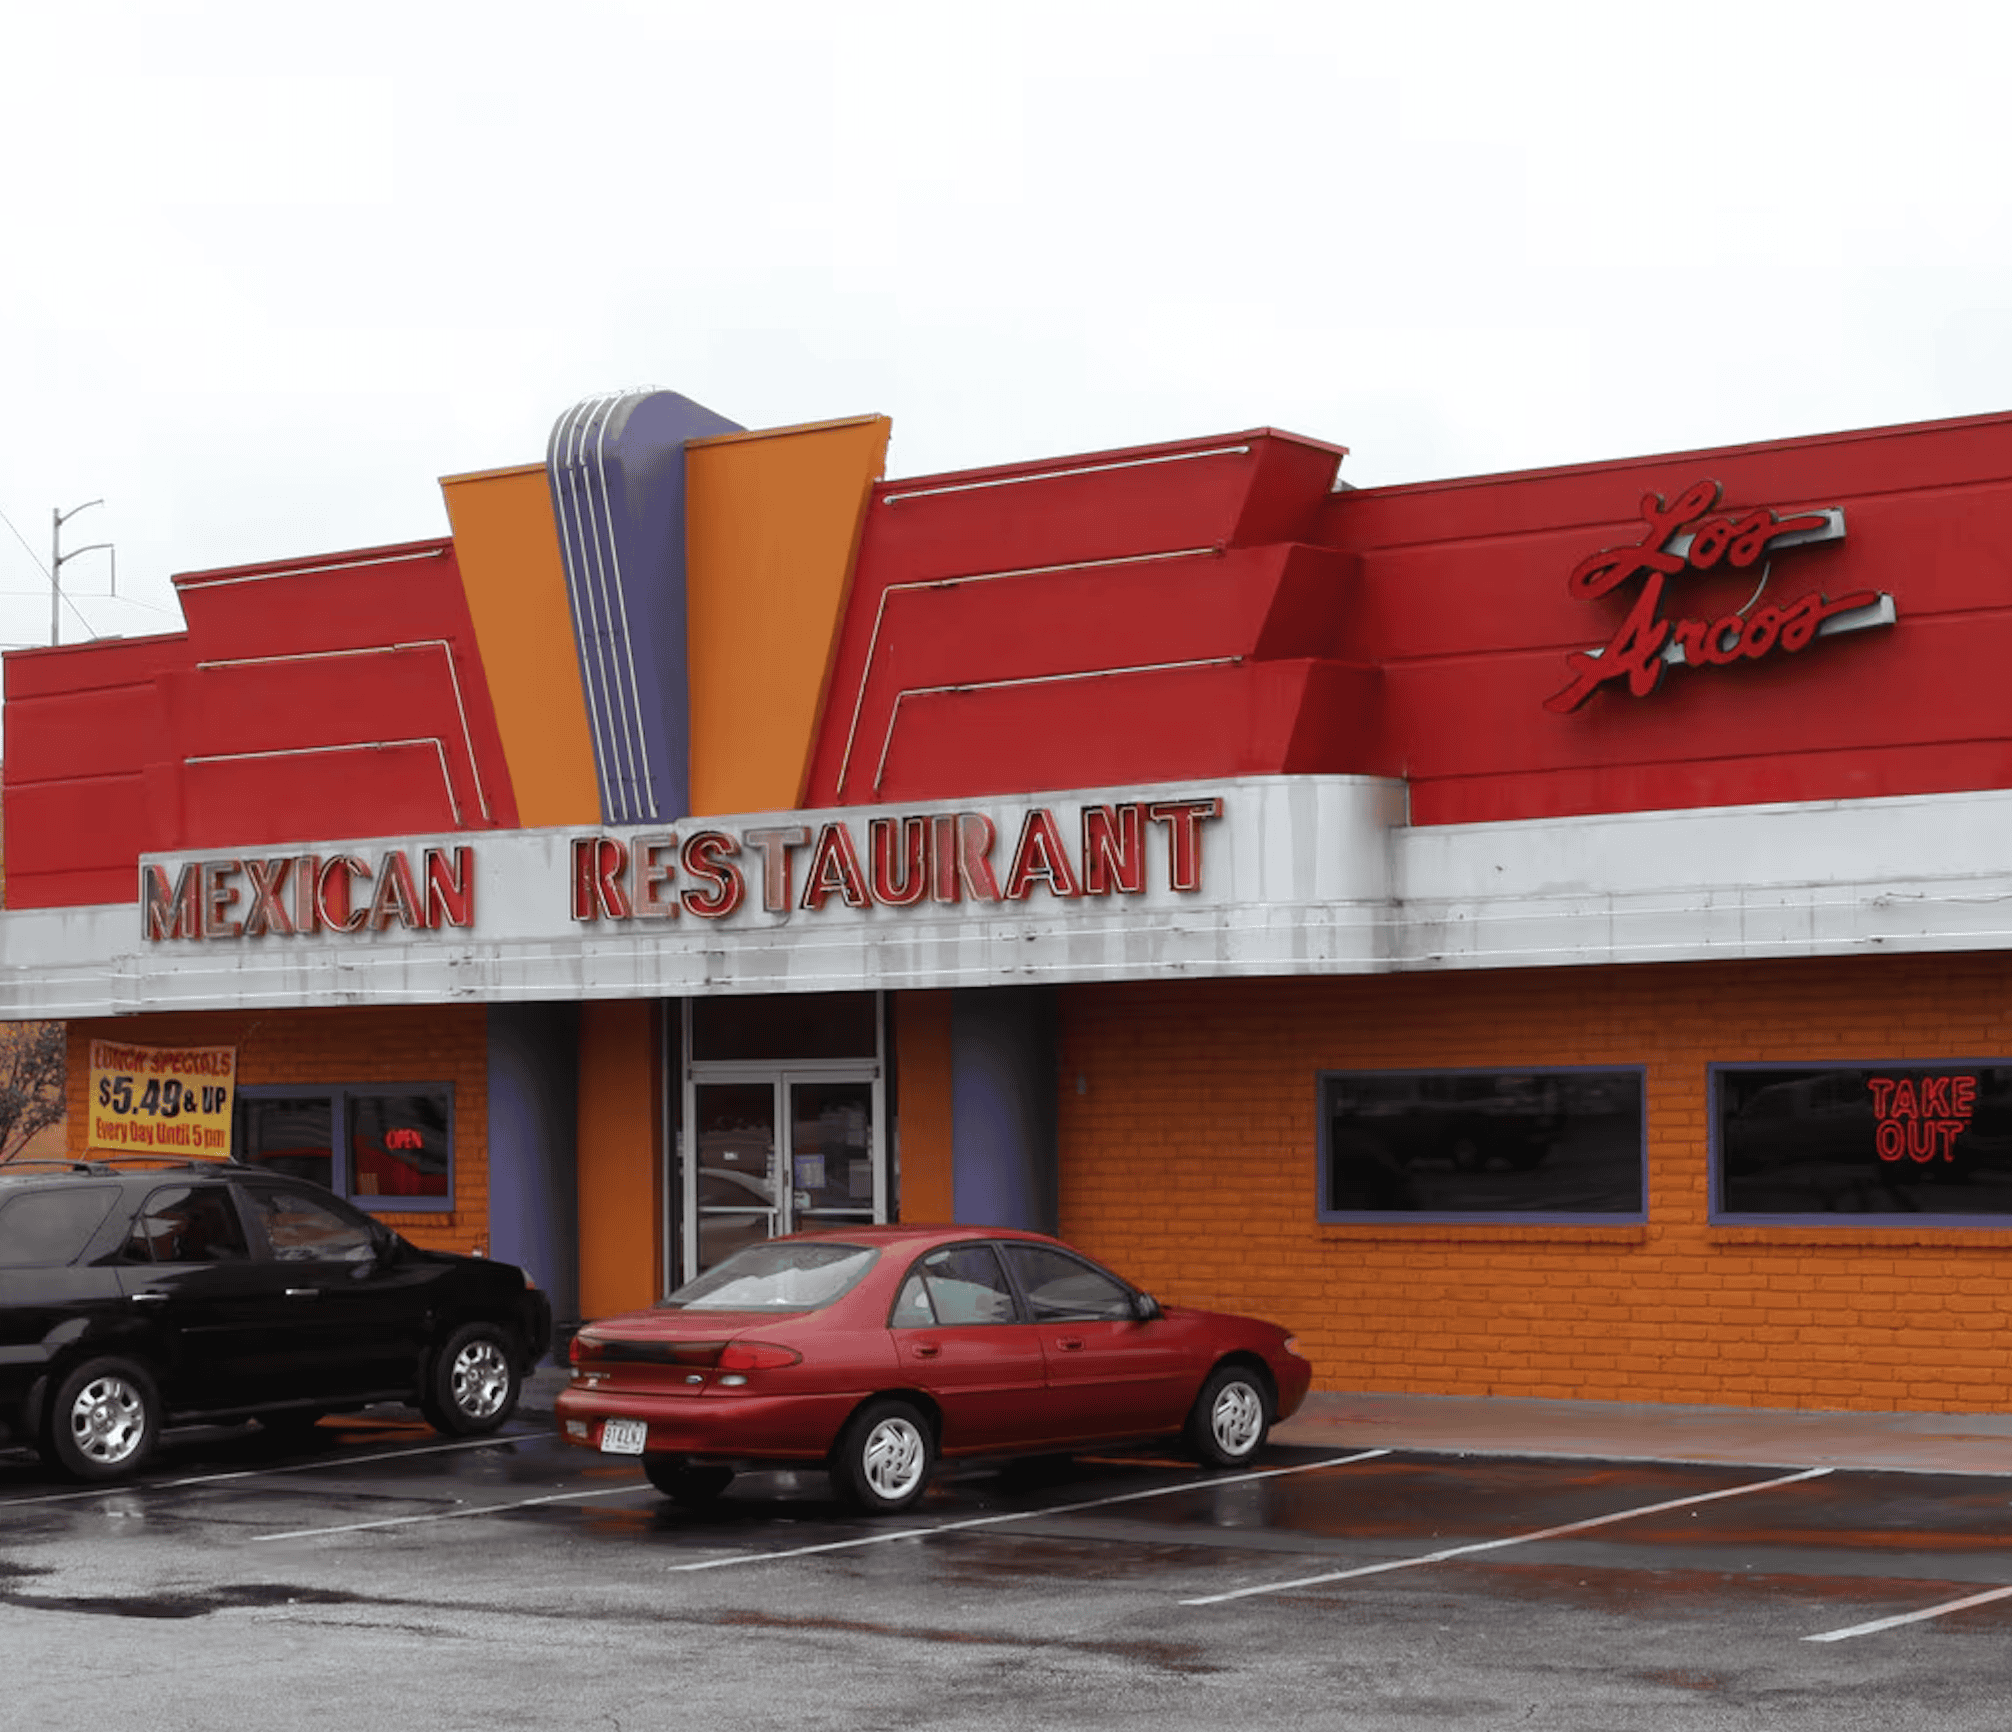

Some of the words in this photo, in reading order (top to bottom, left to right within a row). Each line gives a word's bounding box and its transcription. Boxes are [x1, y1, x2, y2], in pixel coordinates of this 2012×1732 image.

[1569, 480, 1832, 600] Los
[1543, 571, 1884, 713] Arcos
[142, 846, 476, 942] MEXICAN
[570, 797, 1223, 921] RESTAURANT
[94, 1047, 146, 1073] LUNCH
[150, 1051, 231, 1077] SPECIALS
[98, 1076, 183, 1118] $5.49
[201, 1086, 227, 1115] UP
[1868, 1076, 1977, 1119] TAKE
[96, 1116, 128, 1144] Every
[129, 1120, 153, 1146] Day
[156, 1121, 190, 1146] Until
[385, 1128, 424, 1150] OPEN
[1876, 1119, 1965, 1164] OUT
